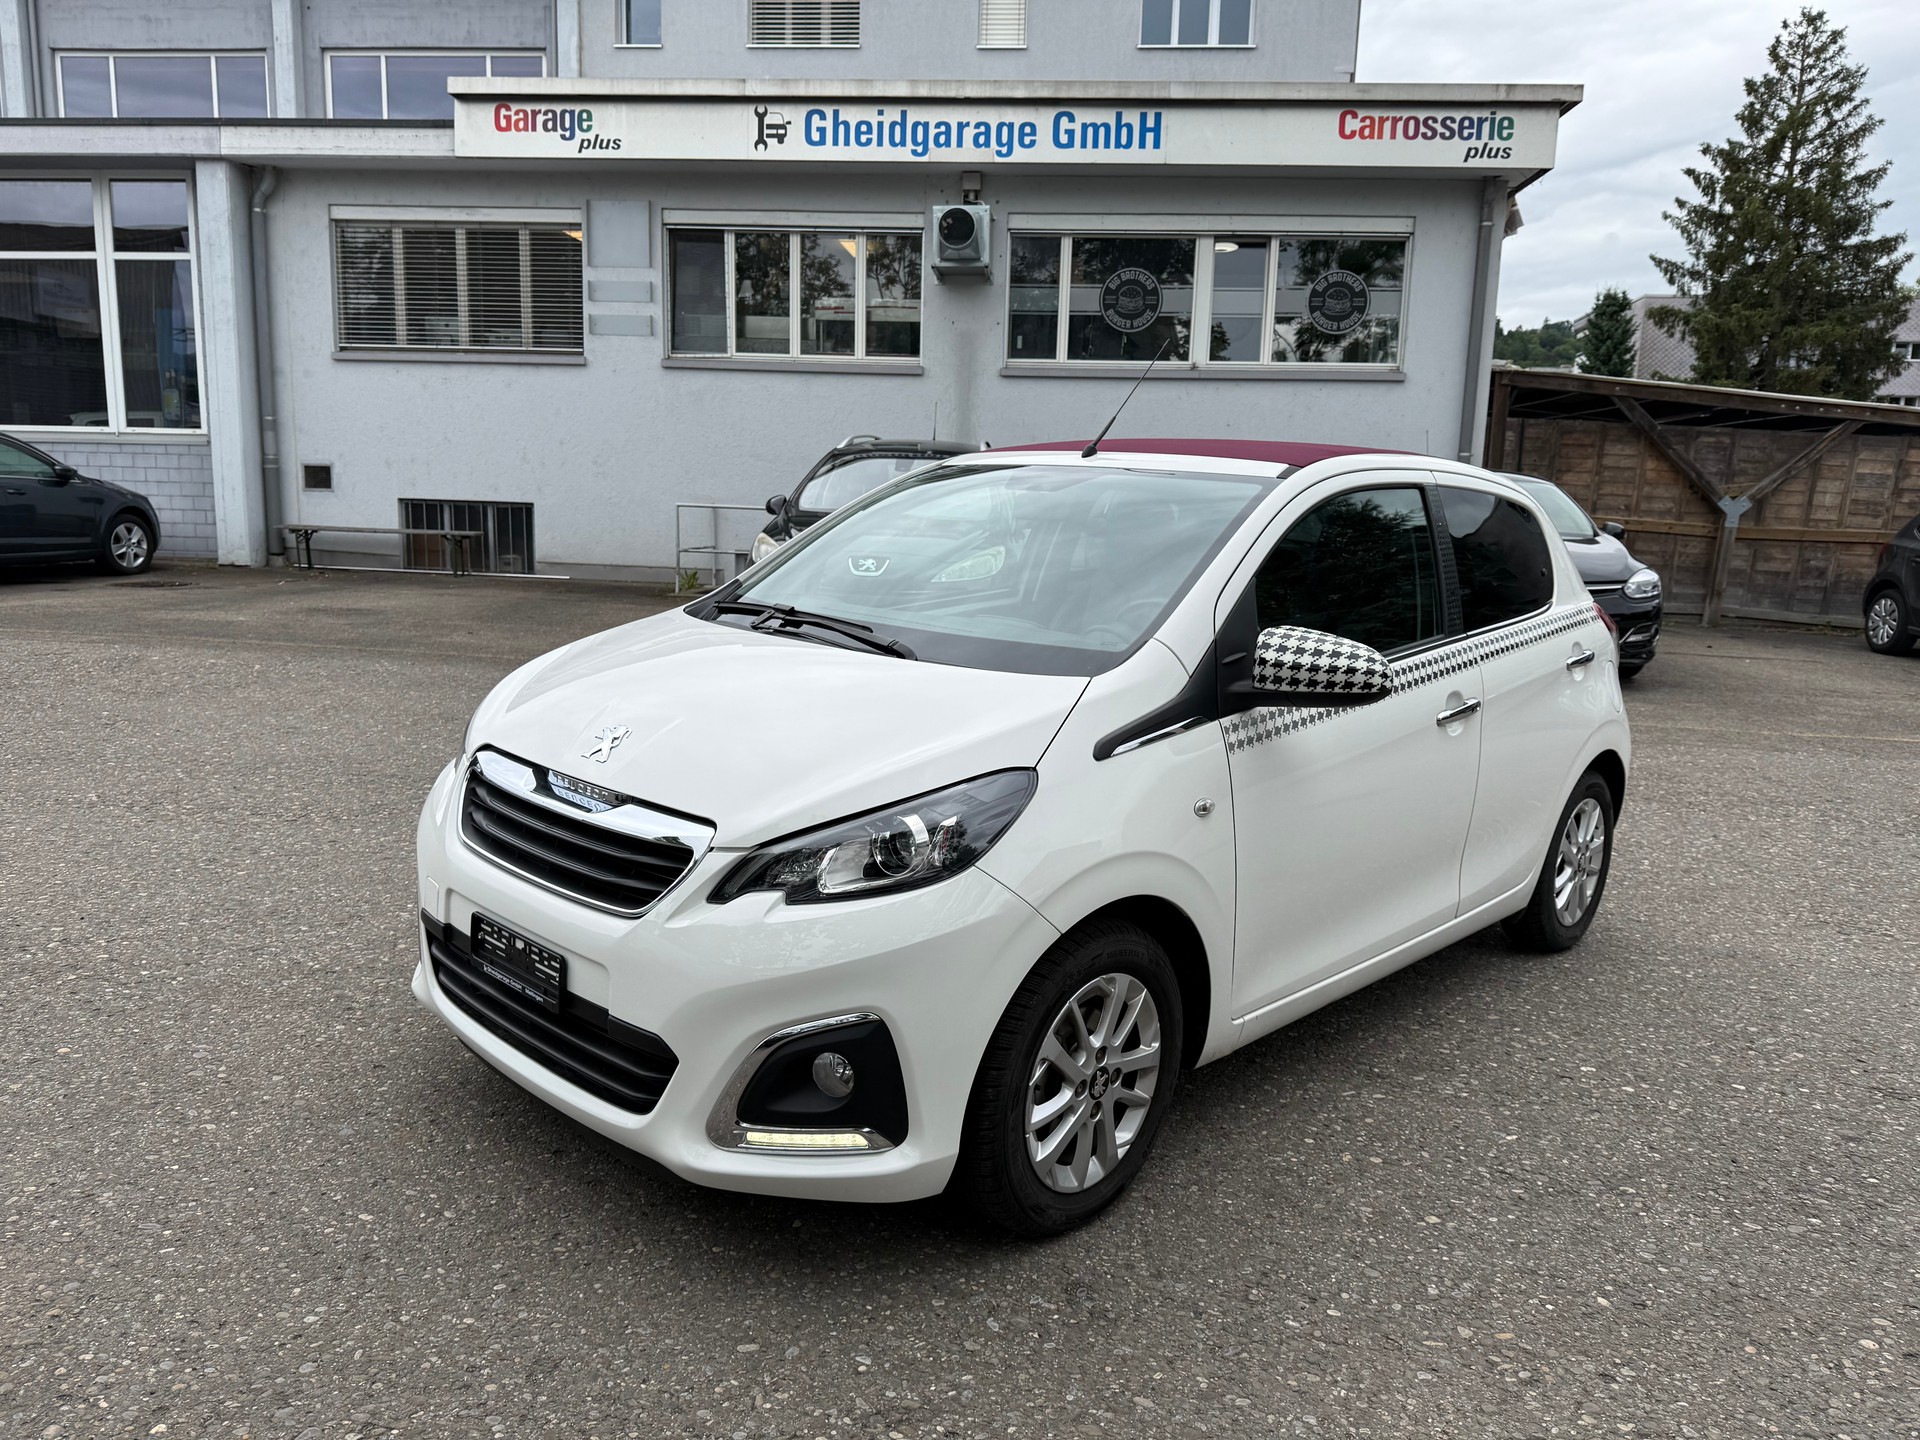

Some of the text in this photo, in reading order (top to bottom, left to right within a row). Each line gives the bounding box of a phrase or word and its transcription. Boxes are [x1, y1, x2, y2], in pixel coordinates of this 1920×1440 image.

[493, 102, 593, 141] Garage
[1338, 109, 1515, 141] Carrosserie
[577, 134, 622, 153] plus
[804, 108, 1163, 158] Gheidgarage GmbH
[1463, 142, 1513, 163] plus
[1107, 270, 1156, 291] BIG BROTHERS
[1314, 272, 1363, 292] BIG BROTHERS
[1105, 308, 1155, 329] BURGER HOUSE
[1311, 310, 1362, 330] BURGER HOUSE
[556, 774, 609, 801] PEUGEOT
